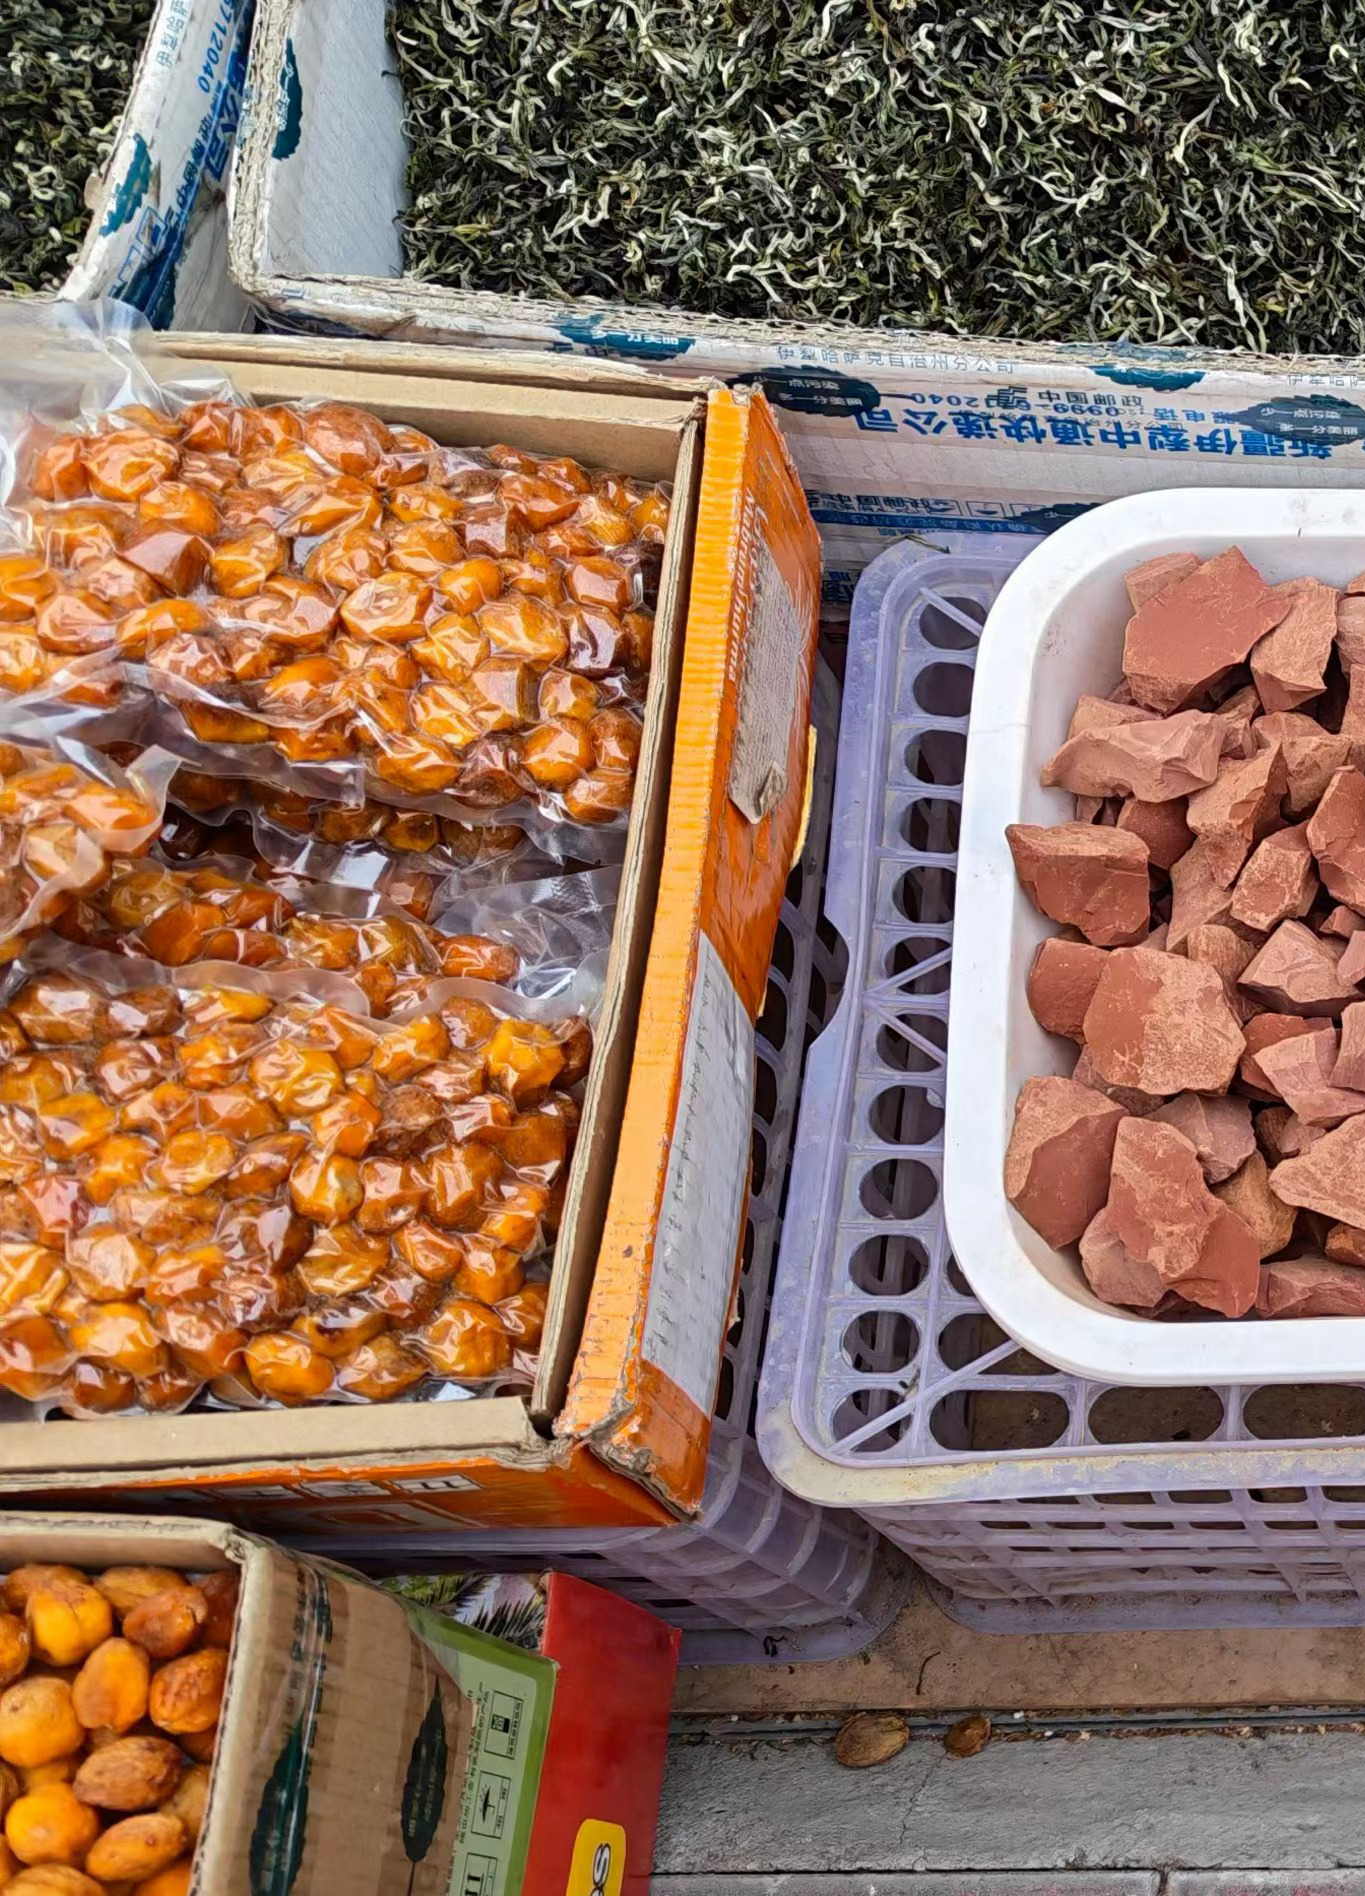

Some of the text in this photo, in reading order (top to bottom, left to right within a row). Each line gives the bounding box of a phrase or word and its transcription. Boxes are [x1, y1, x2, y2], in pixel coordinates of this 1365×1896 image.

[777, 346, 1016, 374] 伊犁哈萨克自治州分公司
[1037, 389, 1144, 407] 中国邮政
[854, 408, 1332, 460] 新疆伊犁中通快递公司
[737, 488, 755, 590] Mabrum
[728, 595, 745, 682] hurma
